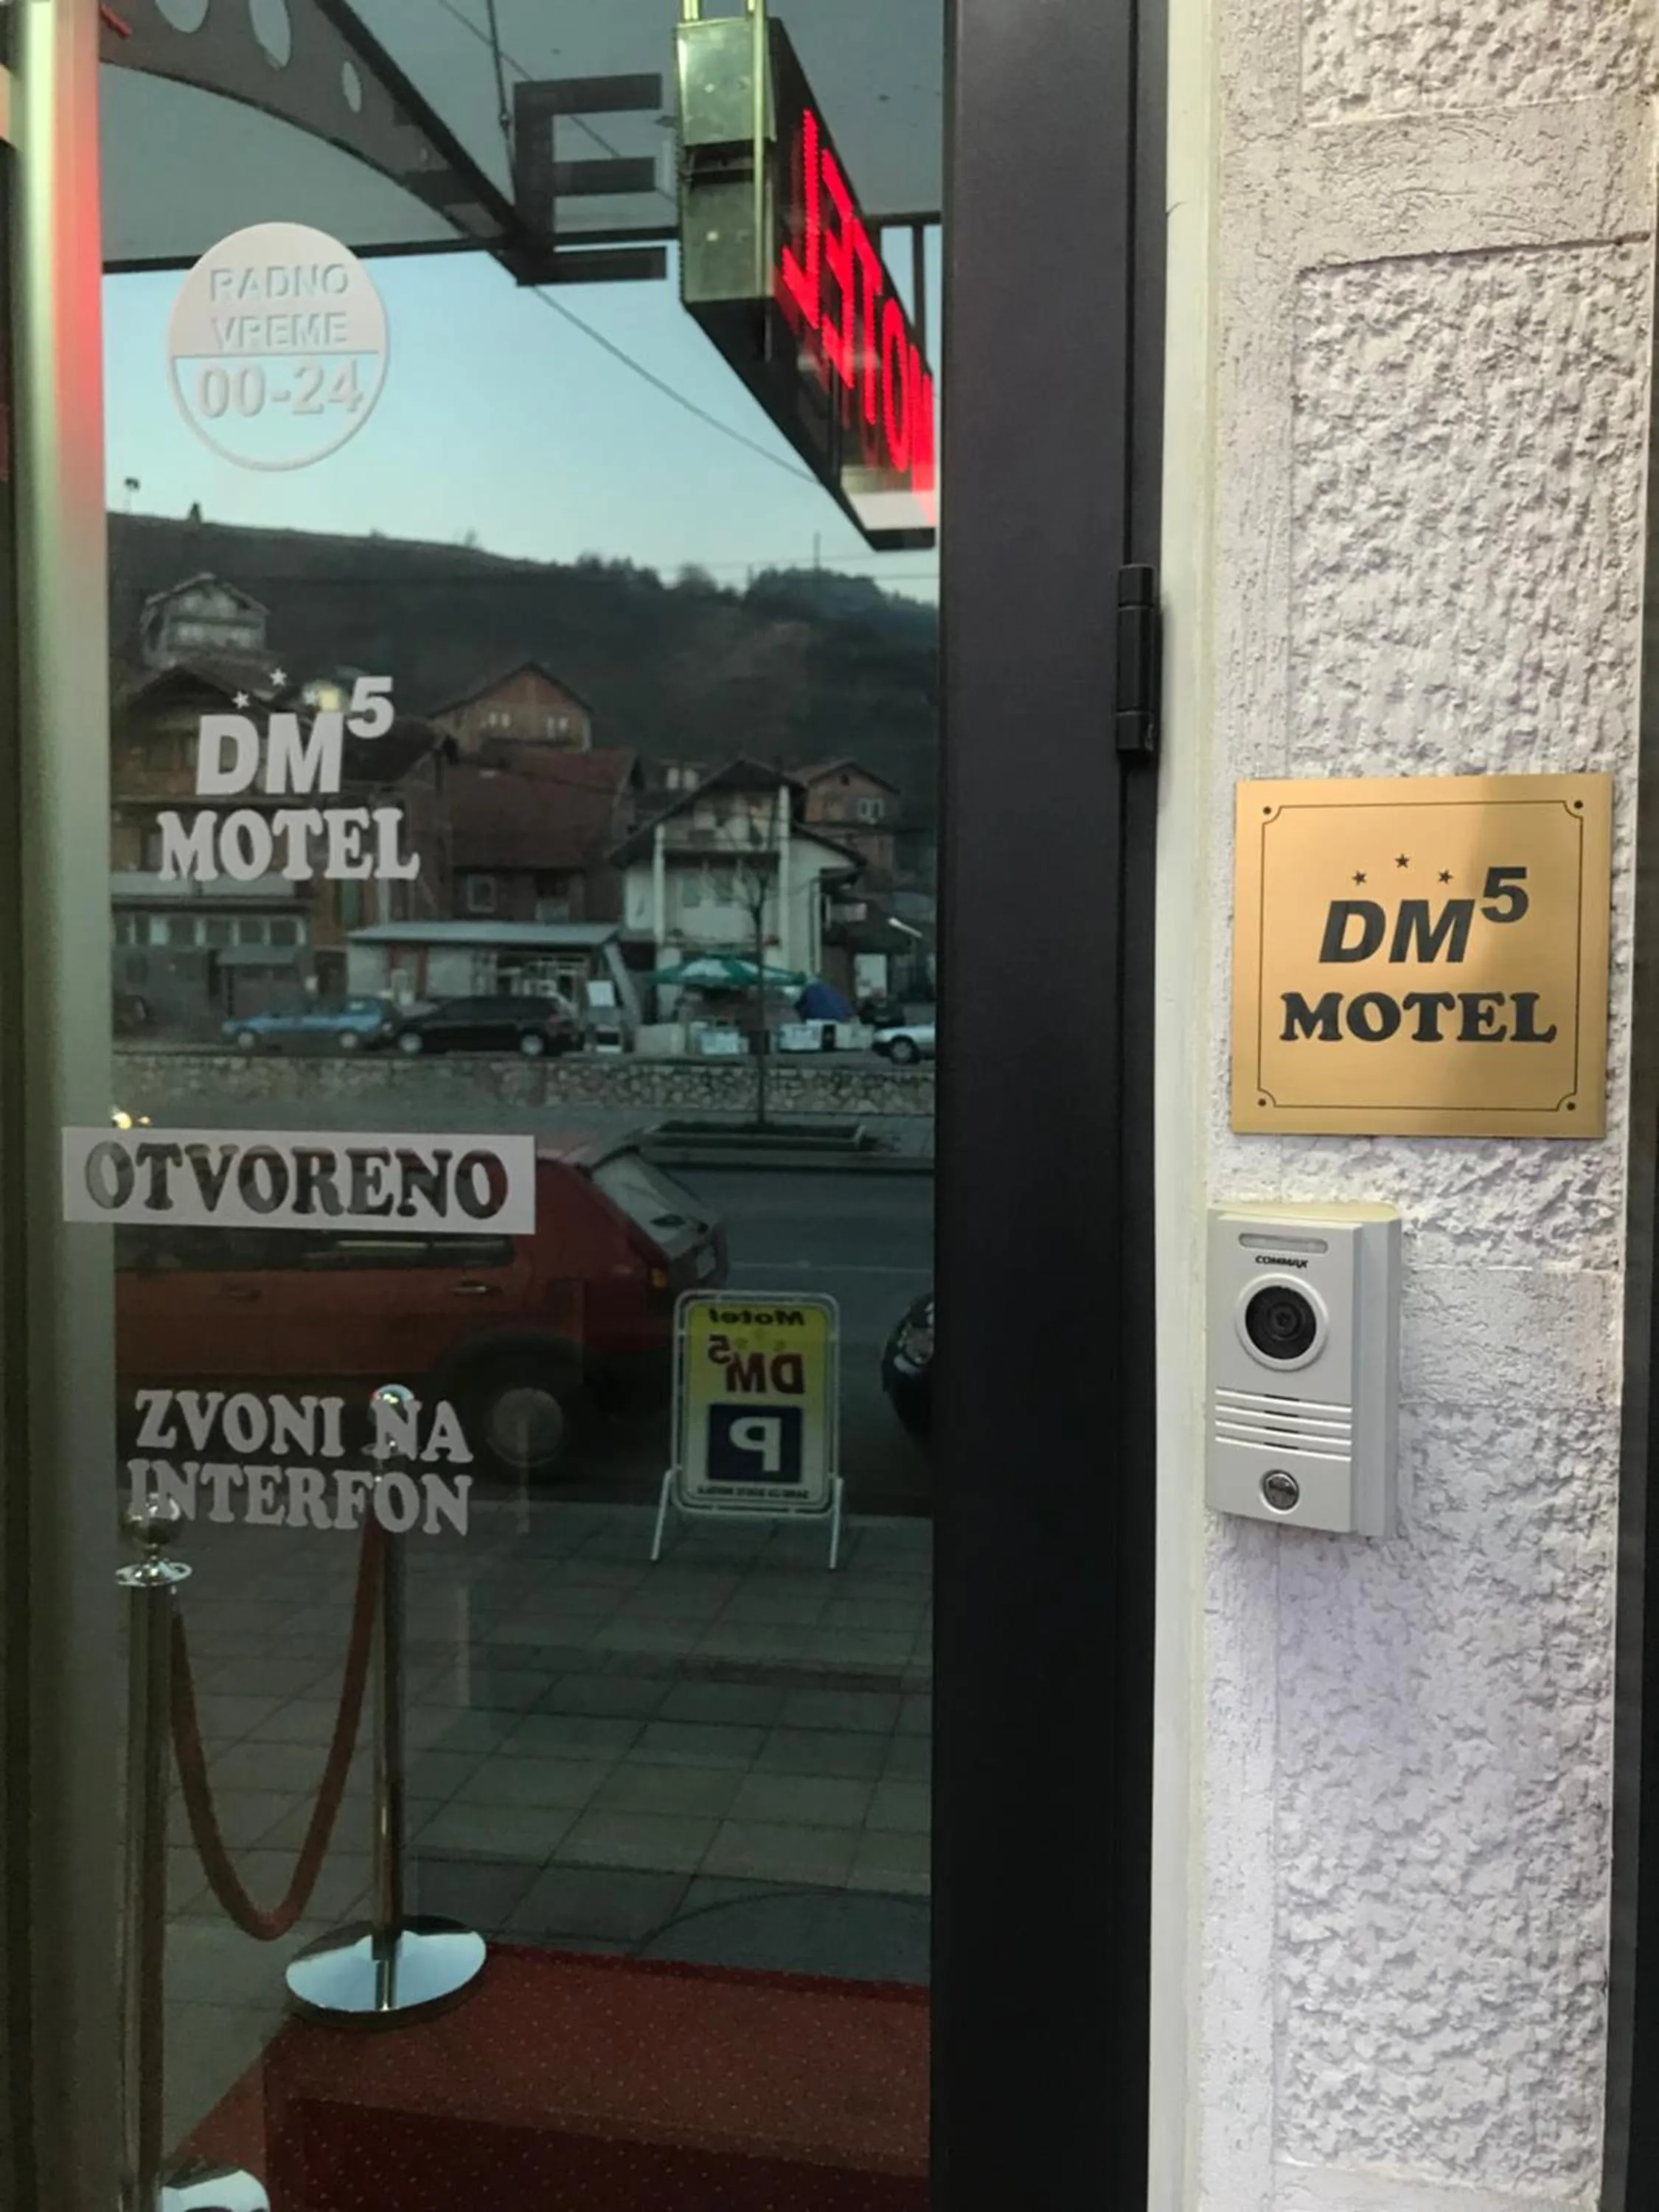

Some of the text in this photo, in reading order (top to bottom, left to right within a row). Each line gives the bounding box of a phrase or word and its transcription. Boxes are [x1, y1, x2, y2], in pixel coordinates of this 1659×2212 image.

[209, 262, 349, 302] RADNO
[209, 311, 349, 349] VREME
[198, 359, 364, 420] 00-24
[156, 807, 421, 882] MOTEL
[1279, 991, 1558, 1043] MOTEL
[85, 1140, 509, 1220] OTVORENO
[1255, 1254, 1309, 1269] COMMAX
[134, 1389, 474, 1464] ZVONI NA
[126, 1458, 473, 1537] INTERFON
